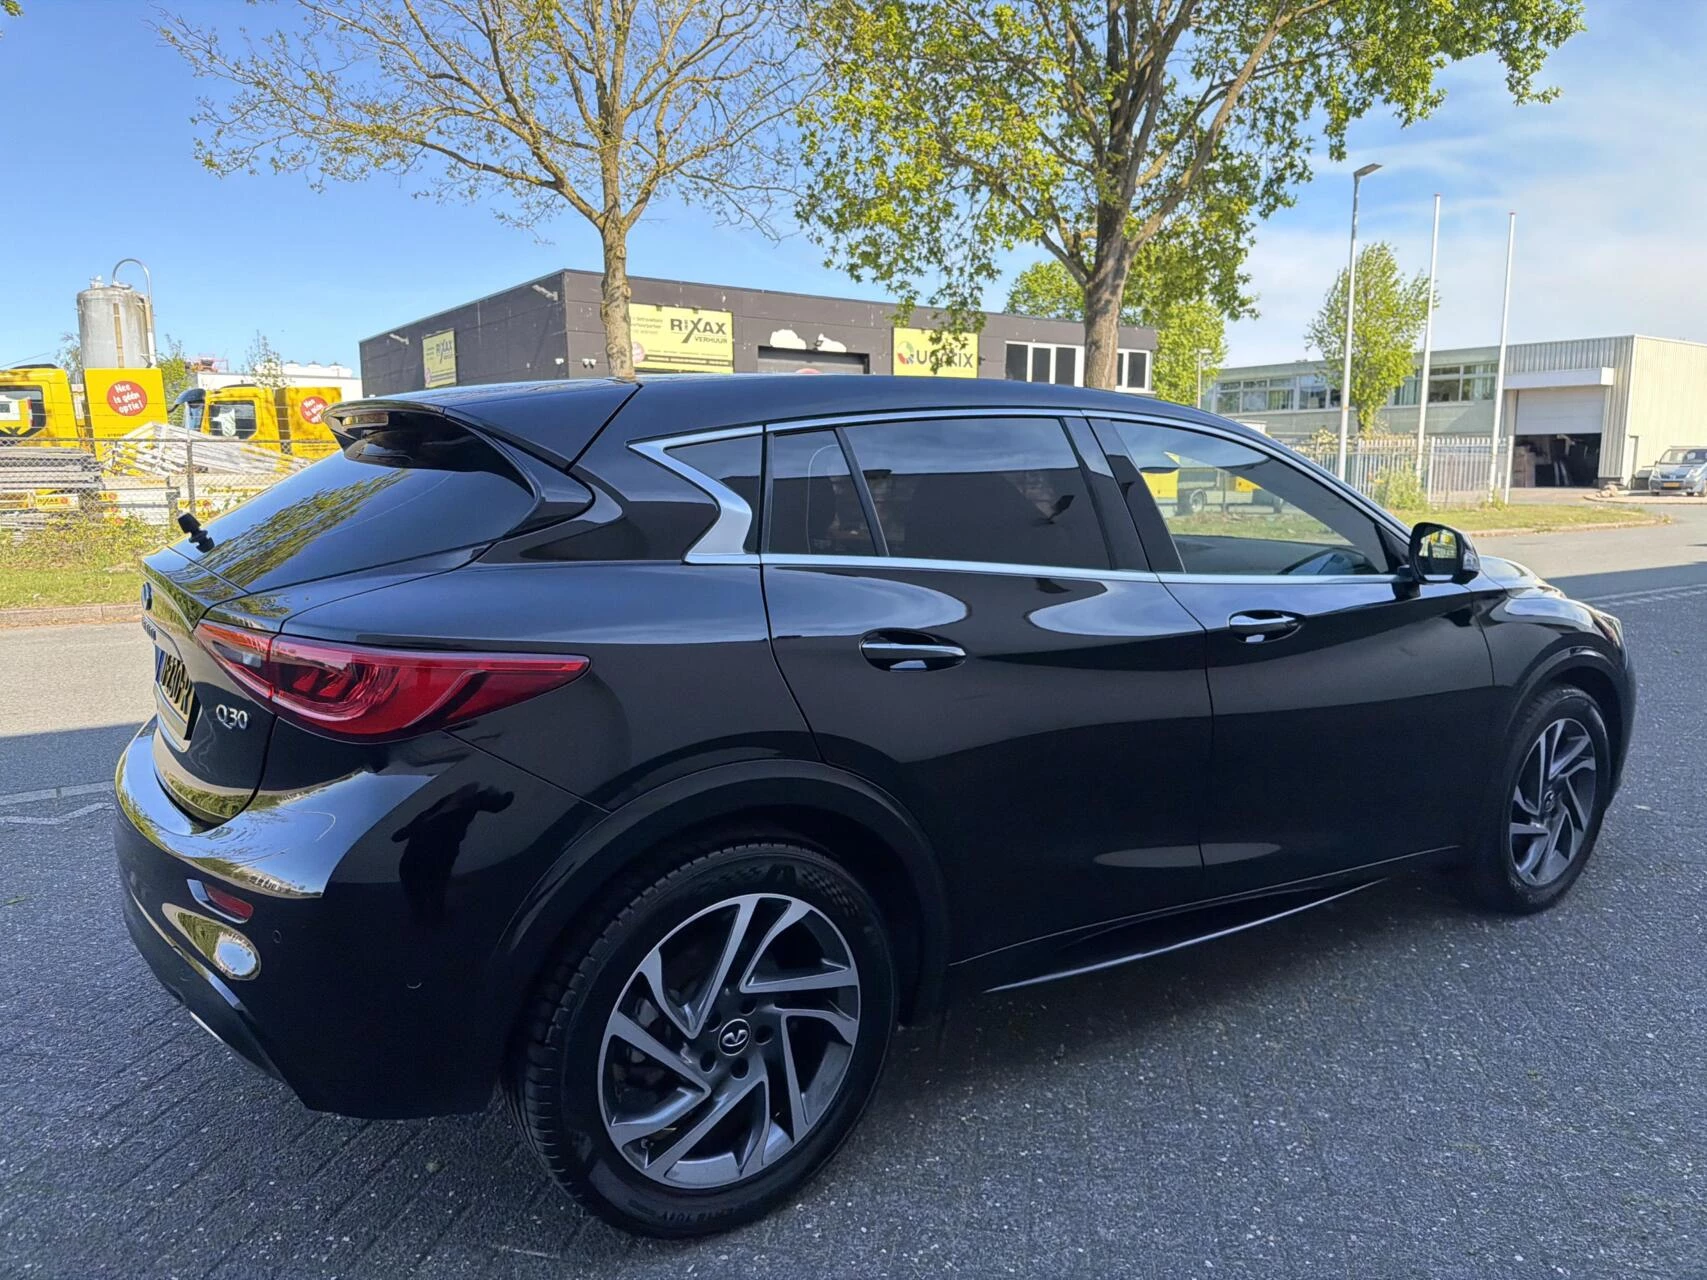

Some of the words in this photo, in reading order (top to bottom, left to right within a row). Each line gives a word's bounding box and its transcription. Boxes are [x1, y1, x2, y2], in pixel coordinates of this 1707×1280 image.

[694, 336, 728, 344] VERHUUR
[115, 383, 132, 393] Nee
[215, 704, 248, 729] Q30
